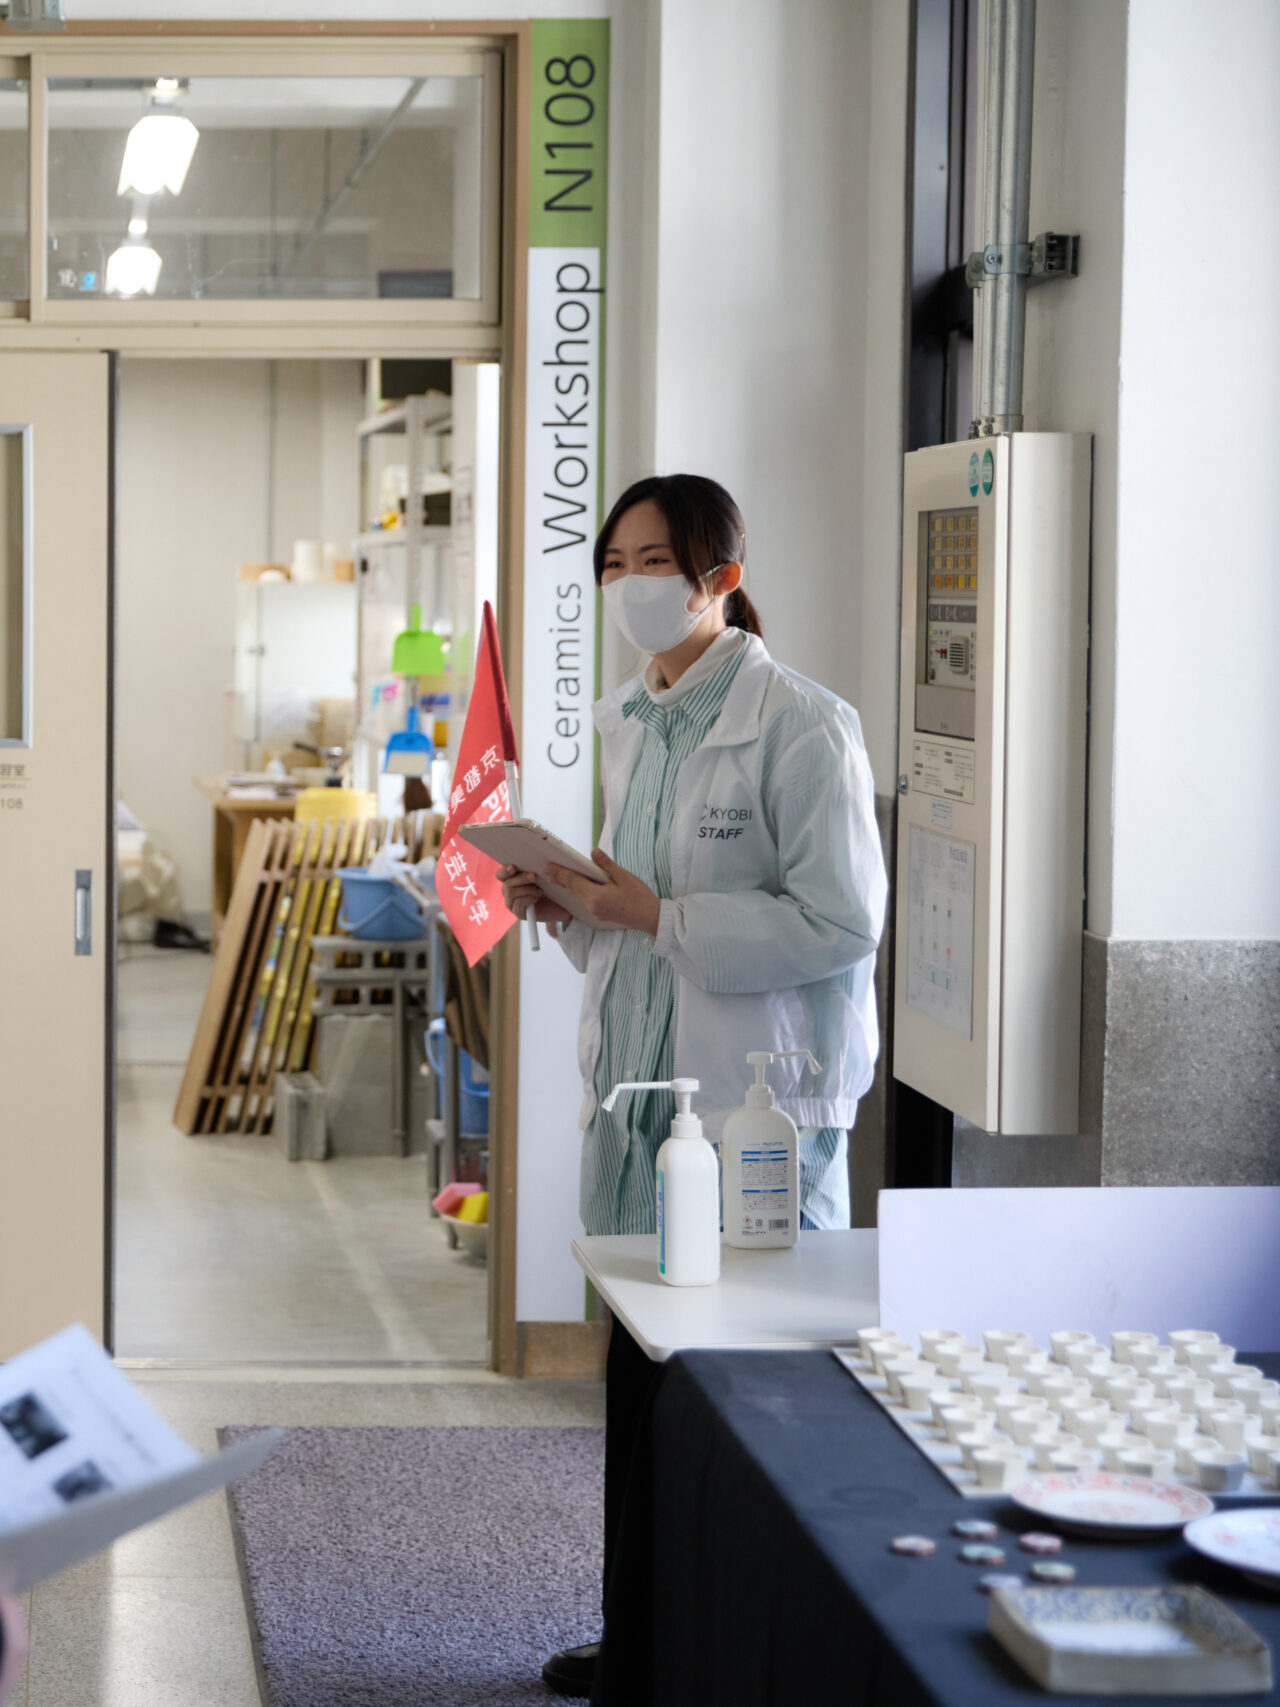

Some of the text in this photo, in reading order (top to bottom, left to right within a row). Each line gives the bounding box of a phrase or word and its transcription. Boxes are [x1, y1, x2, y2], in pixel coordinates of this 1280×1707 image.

[544, 54, 596, 213] N108
[542, 262, 605, 769] Ceramics Workshop
[698, 826, 744, 840] STAFF
[710, 807, 752, 821] KYOBI
